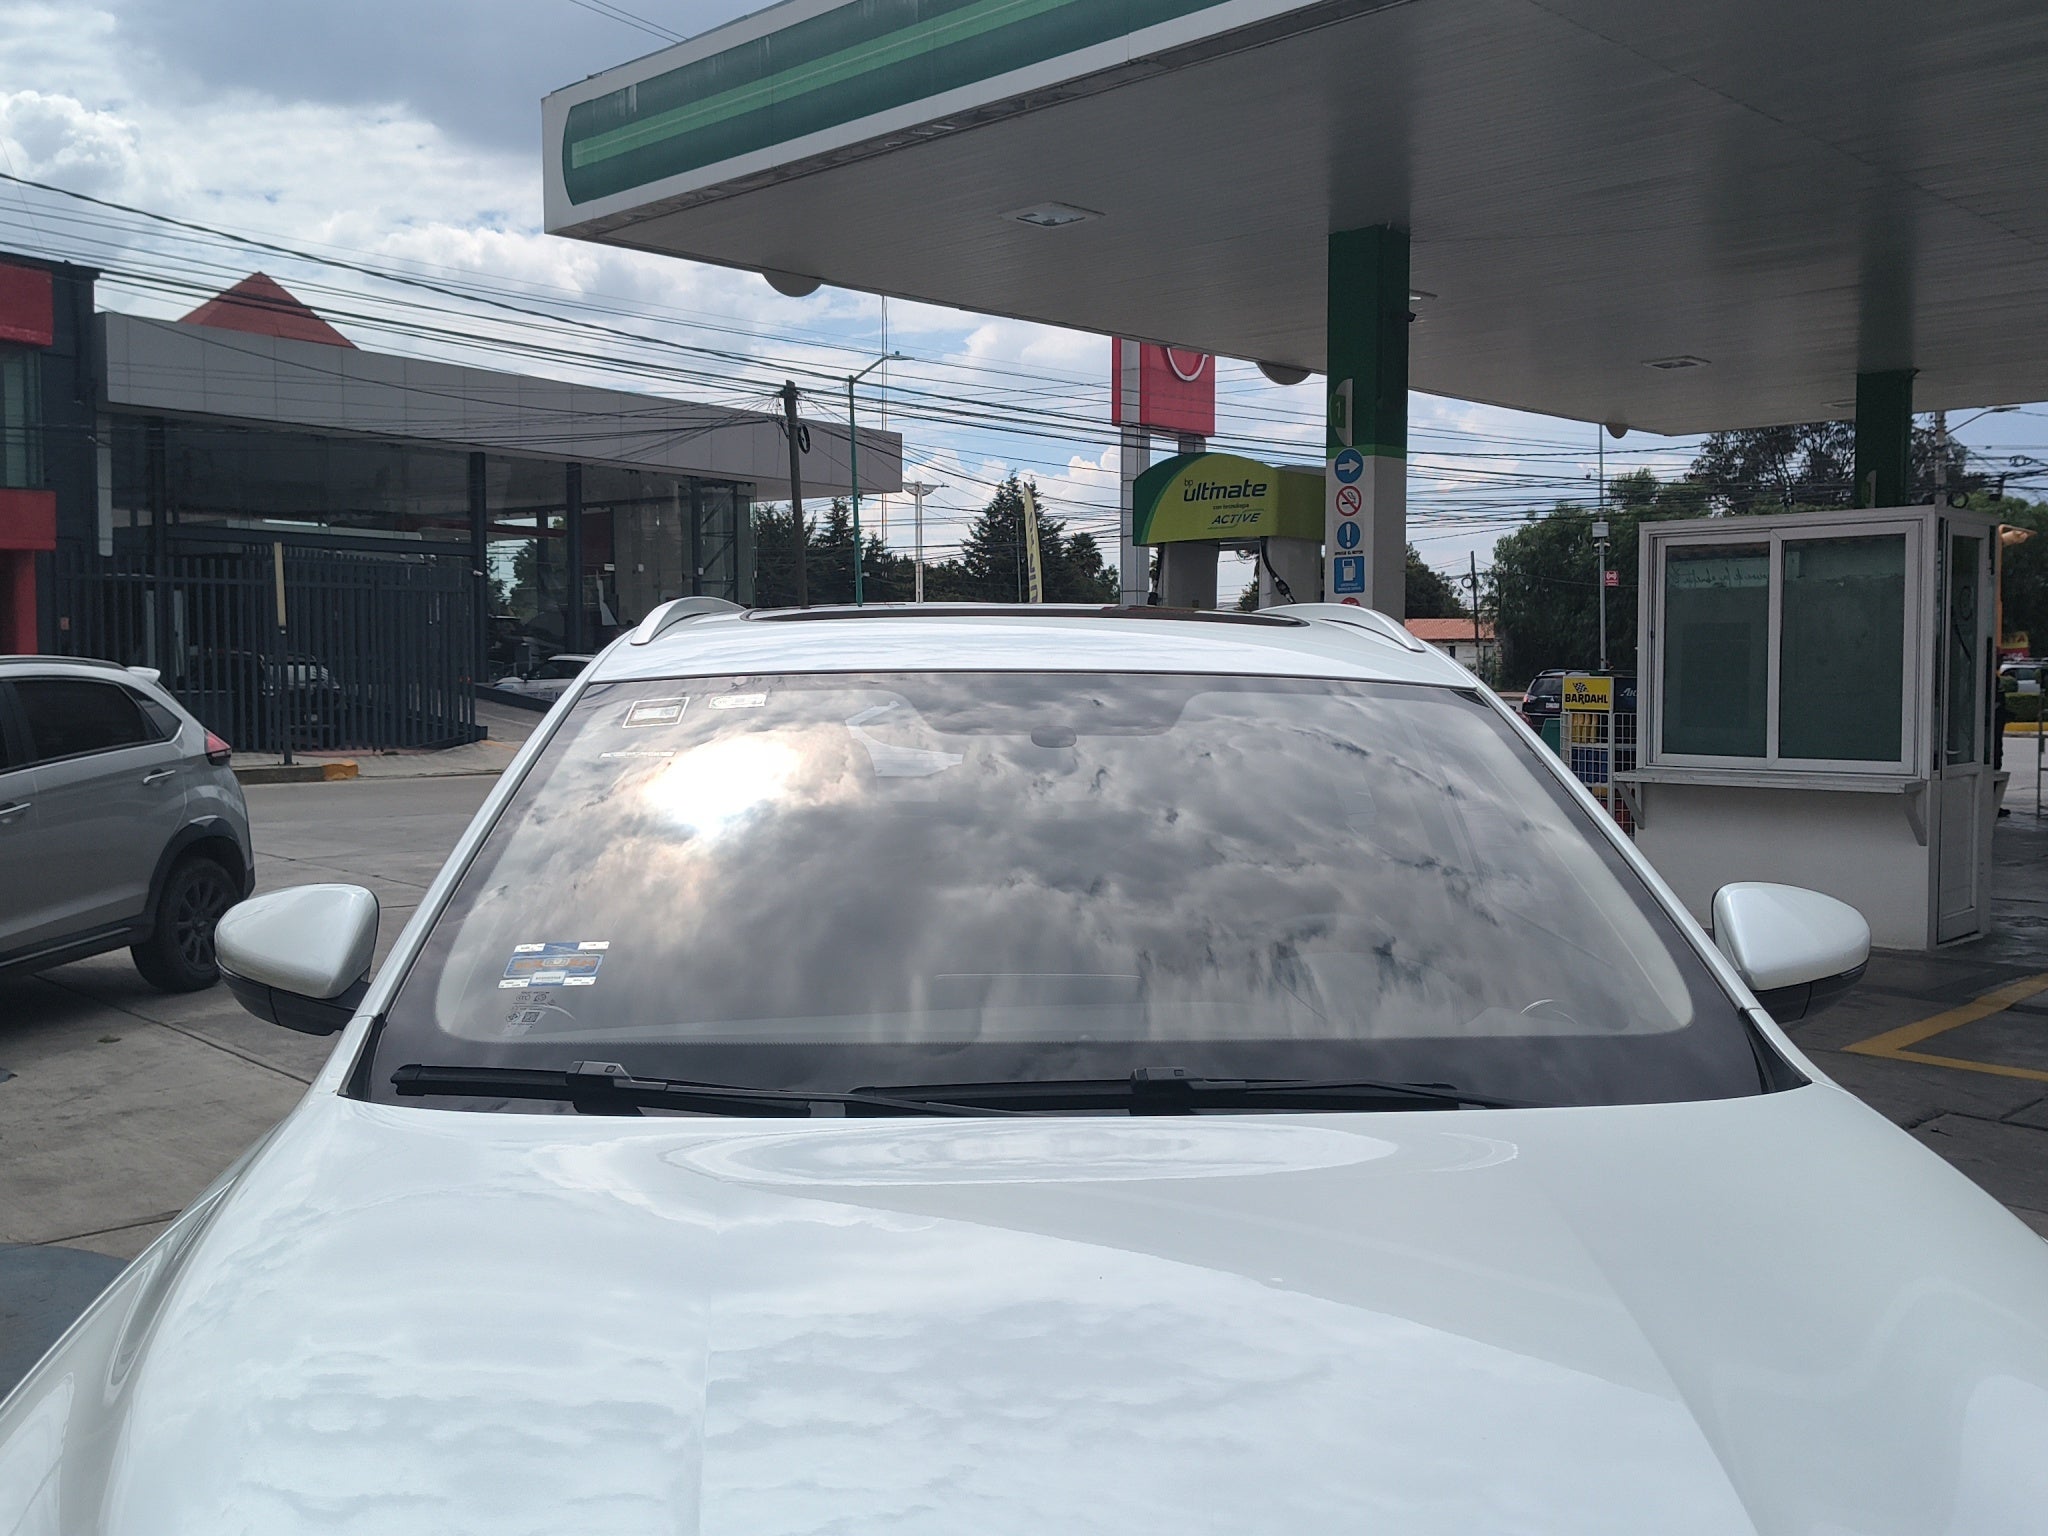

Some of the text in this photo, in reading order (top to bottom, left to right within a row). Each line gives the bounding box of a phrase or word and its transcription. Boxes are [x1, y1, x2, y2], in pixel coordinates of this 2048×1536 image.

[1184, 477, 1194, 488] bp
[1183, 478, 1267, 502] ultimate
[1211, 512, 1261, 525] ACTIVE
[1564, 693, 1609, 705] BARDAHL
